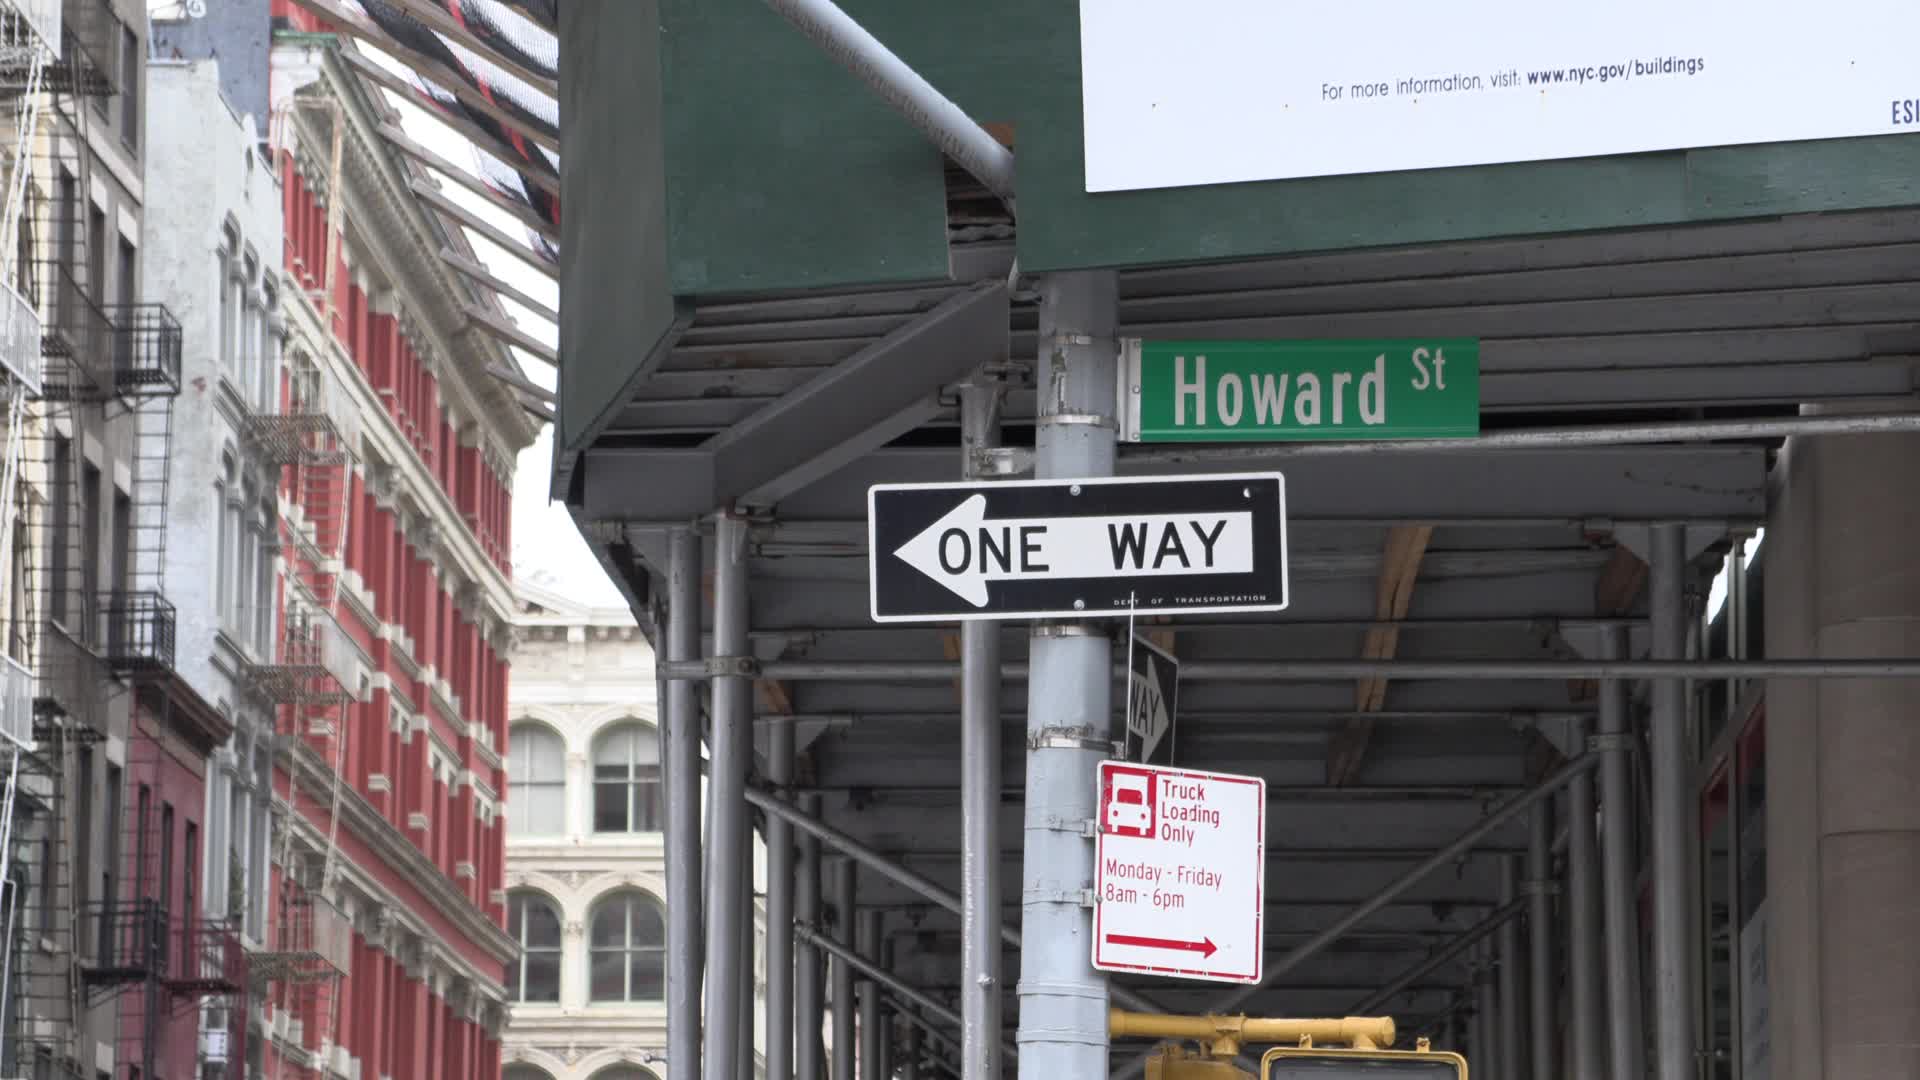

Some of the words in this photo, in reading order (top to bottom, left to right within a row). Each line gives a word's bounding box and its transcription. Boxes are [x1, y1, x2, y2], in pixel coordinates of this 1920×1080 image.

[1322, 84, 1343, 101] For
[1351, 82, 1389, 98] more
[1397, 73, 1484, 95] information,
[1490, 69, 1521, 86] visit:
[1527, 56, 1704, 85] www.nyc.gov/buildings
[1175, 354, 1385, 426] Howard
[1411, 348, 1446, 390] St
[938, 526, 1049, 574] ONE
[1107, 520, 1227, 570] WAY
[1175, 595, 1266, 604] TRANSPORTATION
[1163, 779, 1205, 801] Truck
[1161, 801, 1220, 828] Loading
[1161, 823, 1194, 847] Only
[1106, 858, 1162, 885] Monday
[1177, 865, 1222, 891] Friday
[1105, 883, 1137, 904] 8am
[1153, 888, 1184, 910] 6pm
